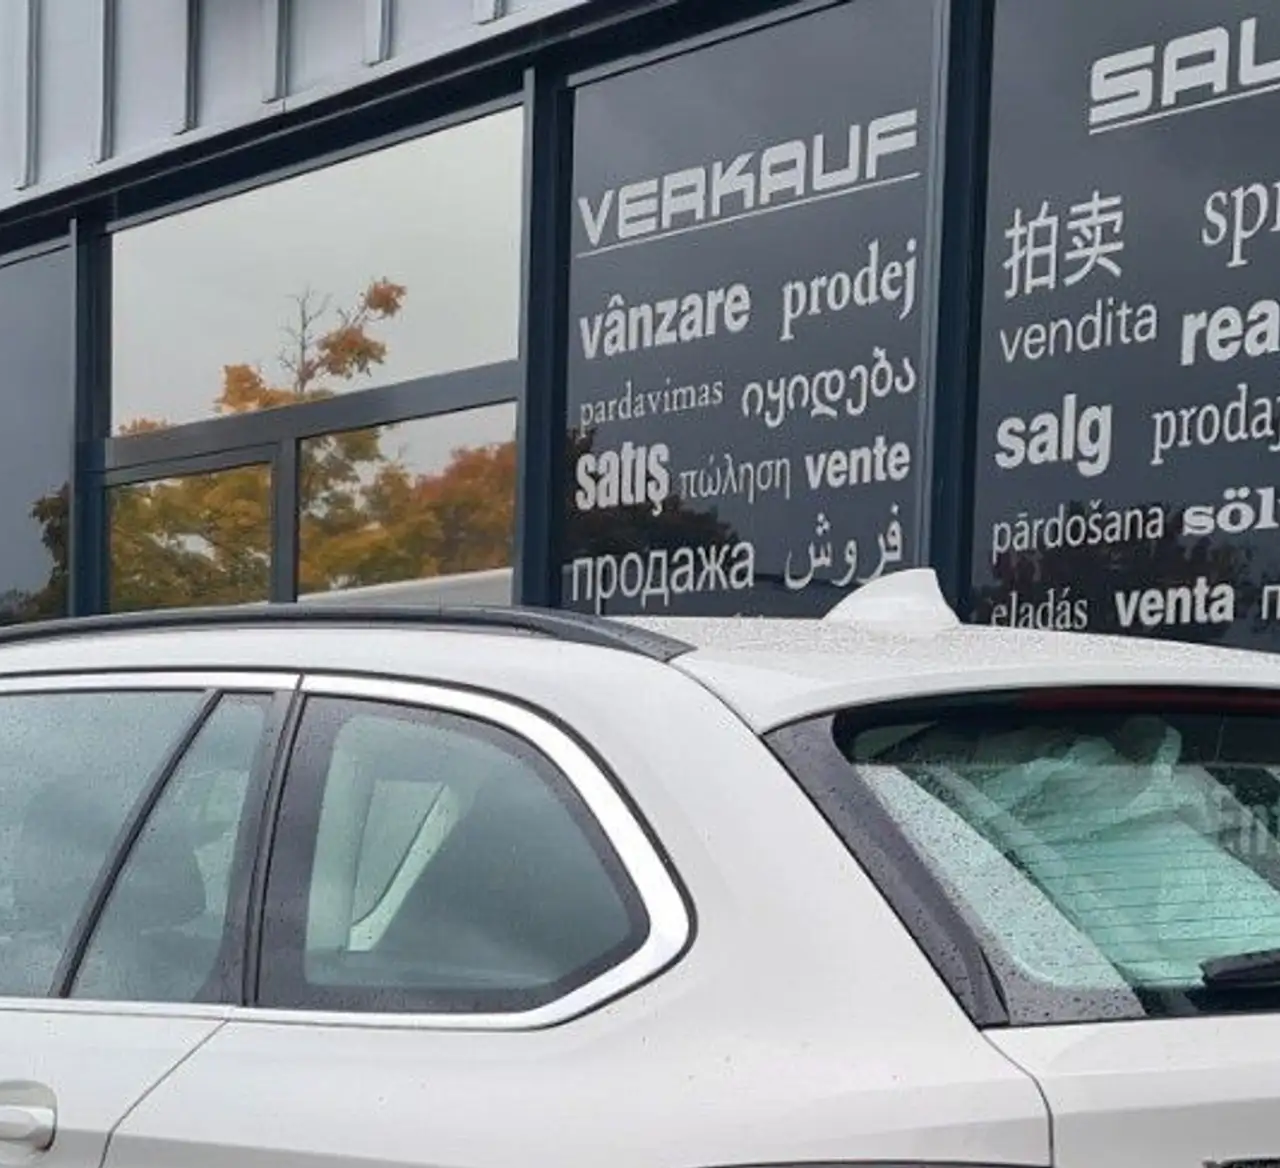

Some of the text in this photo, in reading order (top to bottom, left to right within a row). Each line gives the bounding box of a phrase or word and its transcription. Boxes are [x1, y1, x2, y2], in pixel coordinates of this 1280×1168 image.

[577, 109, 918, 247] VERKAUF
[1003, 190, 1124, 300] 拍卖
[579, 239, 917, 360] vânzare prodej
[1000, 297, 1158, 364] vendita
[579, 379, 724, 439] pardavimas
[995, 394, 1112, 477] salg
[679, 454, 791, 504] πώληση
[804, 436, 911, 490] vente
[991, 499, 1164, 565] pārdošana
[572, 541, 755, 616] продажа
[990, 576, 1235, 629] eladás venta
